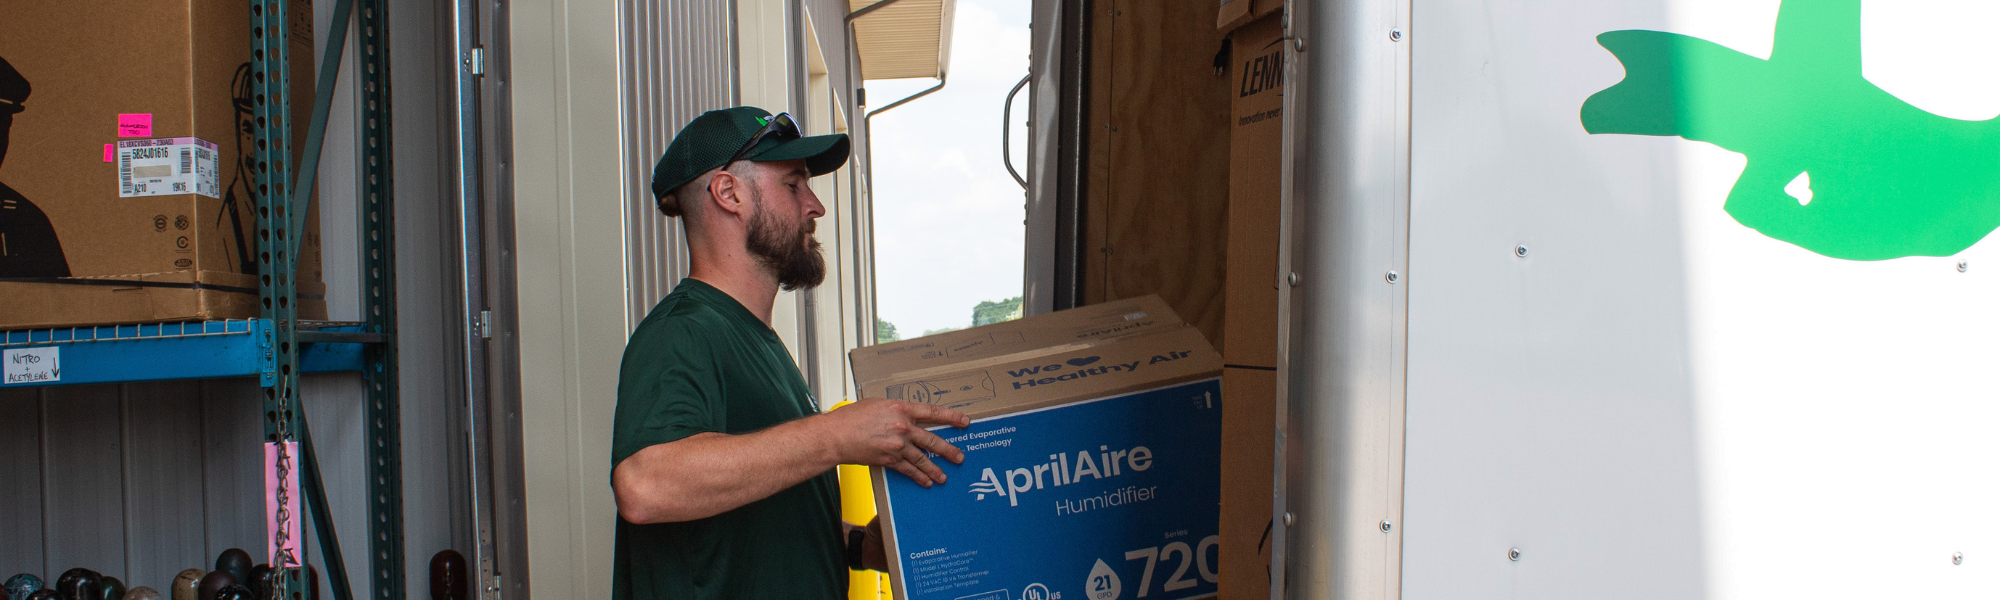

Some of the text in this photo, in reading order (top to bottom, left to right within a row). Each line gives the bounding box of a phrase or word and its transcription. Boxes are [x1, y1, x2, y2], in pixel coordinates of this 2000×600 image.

[1240, 51, 1283, 98] LENN
[13, 353, 40, 365] NITRO
[9, 371, 48, 382] ACETYLENE
[1007, 364, 1062, 378] We
[1012, 350, 1192, 390] Healthy Air
[945, 426, 1016, 443] wered Evaporative
[966, 439, 1012, 452] Technology
[968, 445, 1152, 507] AprilAire
[1056, 486, 1157, 516] Humidifier
[1164, 528, 1188, 539] Series
[910, 548, 948, 559] Contains:
[1093, 575, 1112, 591] 21
